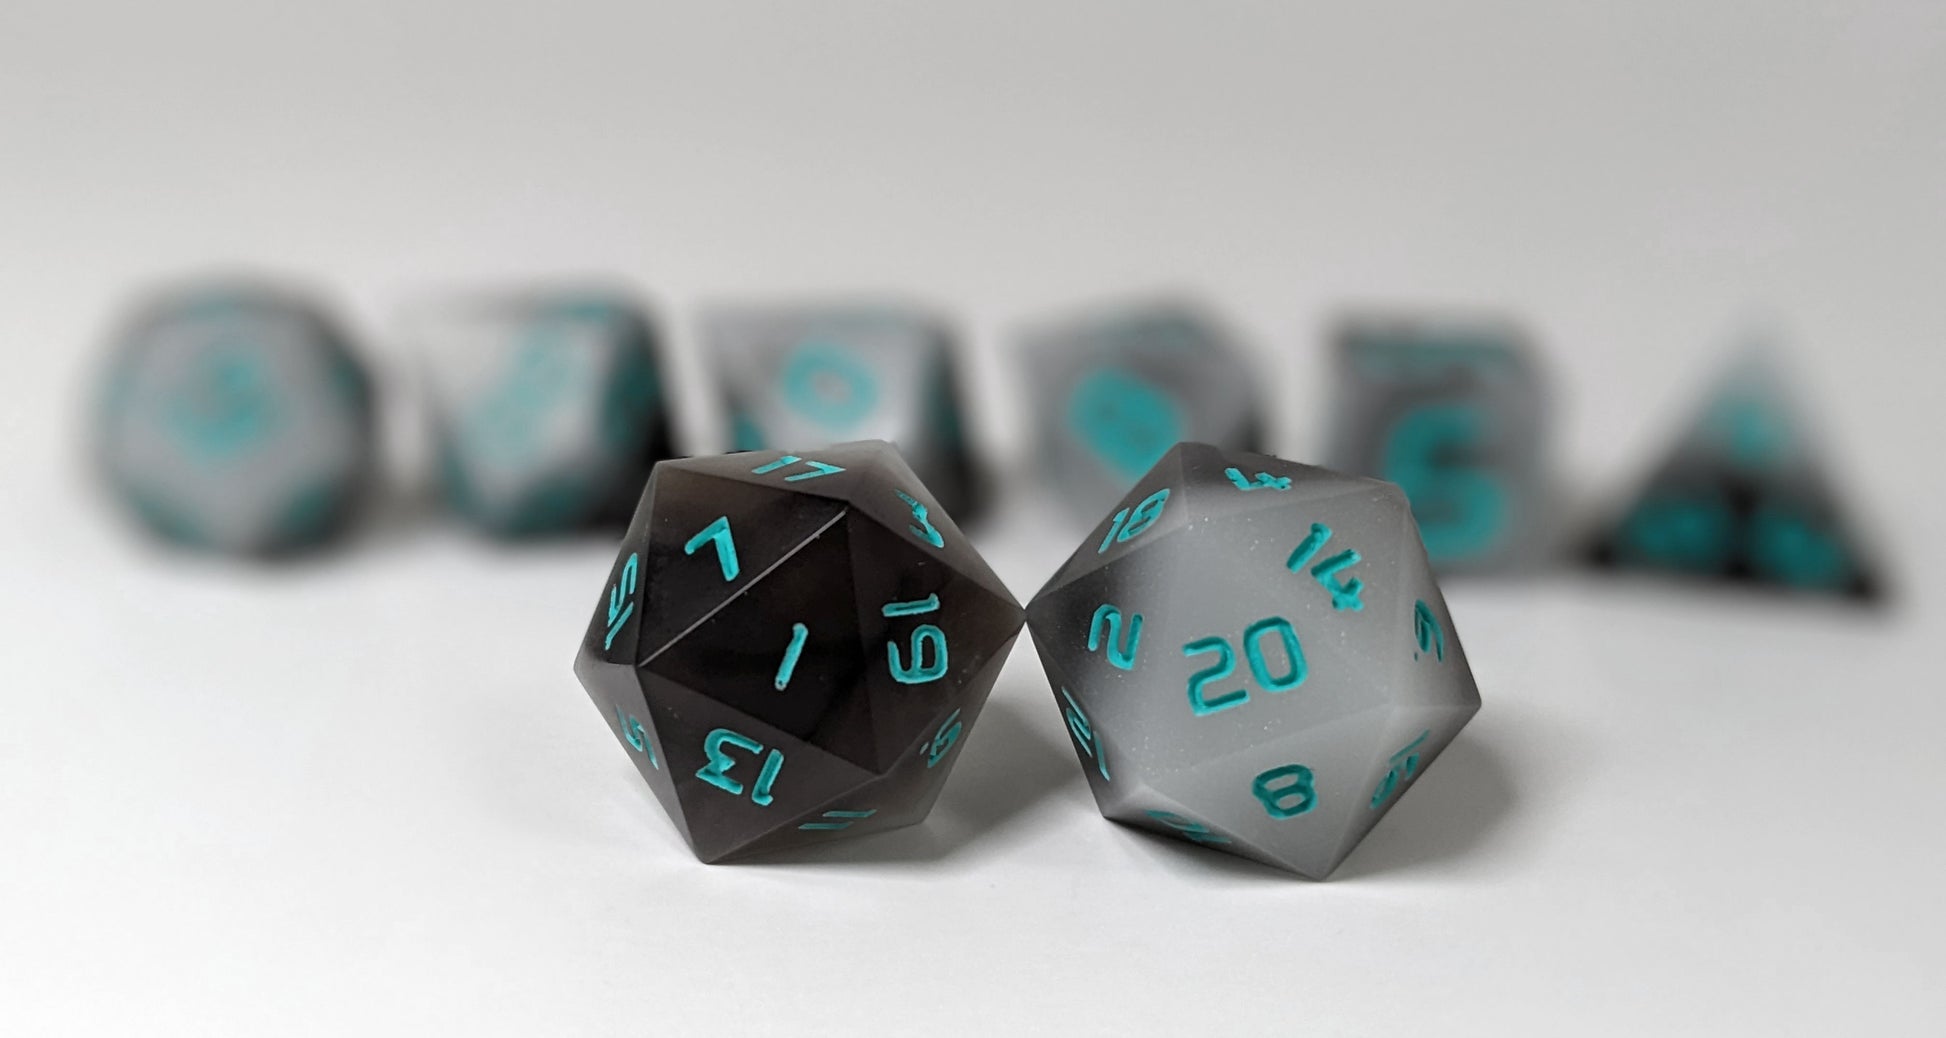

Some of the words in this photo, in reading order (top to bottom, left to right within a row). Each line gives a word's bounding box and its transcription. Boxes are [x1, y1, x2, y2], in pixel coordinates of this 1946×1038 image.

[751, 455, 847, 482] 17
[683, 516, 741, 583] 7
[1097, 488, 1171, 554] 18
[1286, 522, 1365, 612] 14
[774, 622, 811, 692] 1
[881, 592, 949, 686] 19
[1086, 603, 1144, 672] 2
[1181, 615, 1309, 717] 20
[694, 727, 786, 807] 13
[1252, 764, 1319, 820] 8
